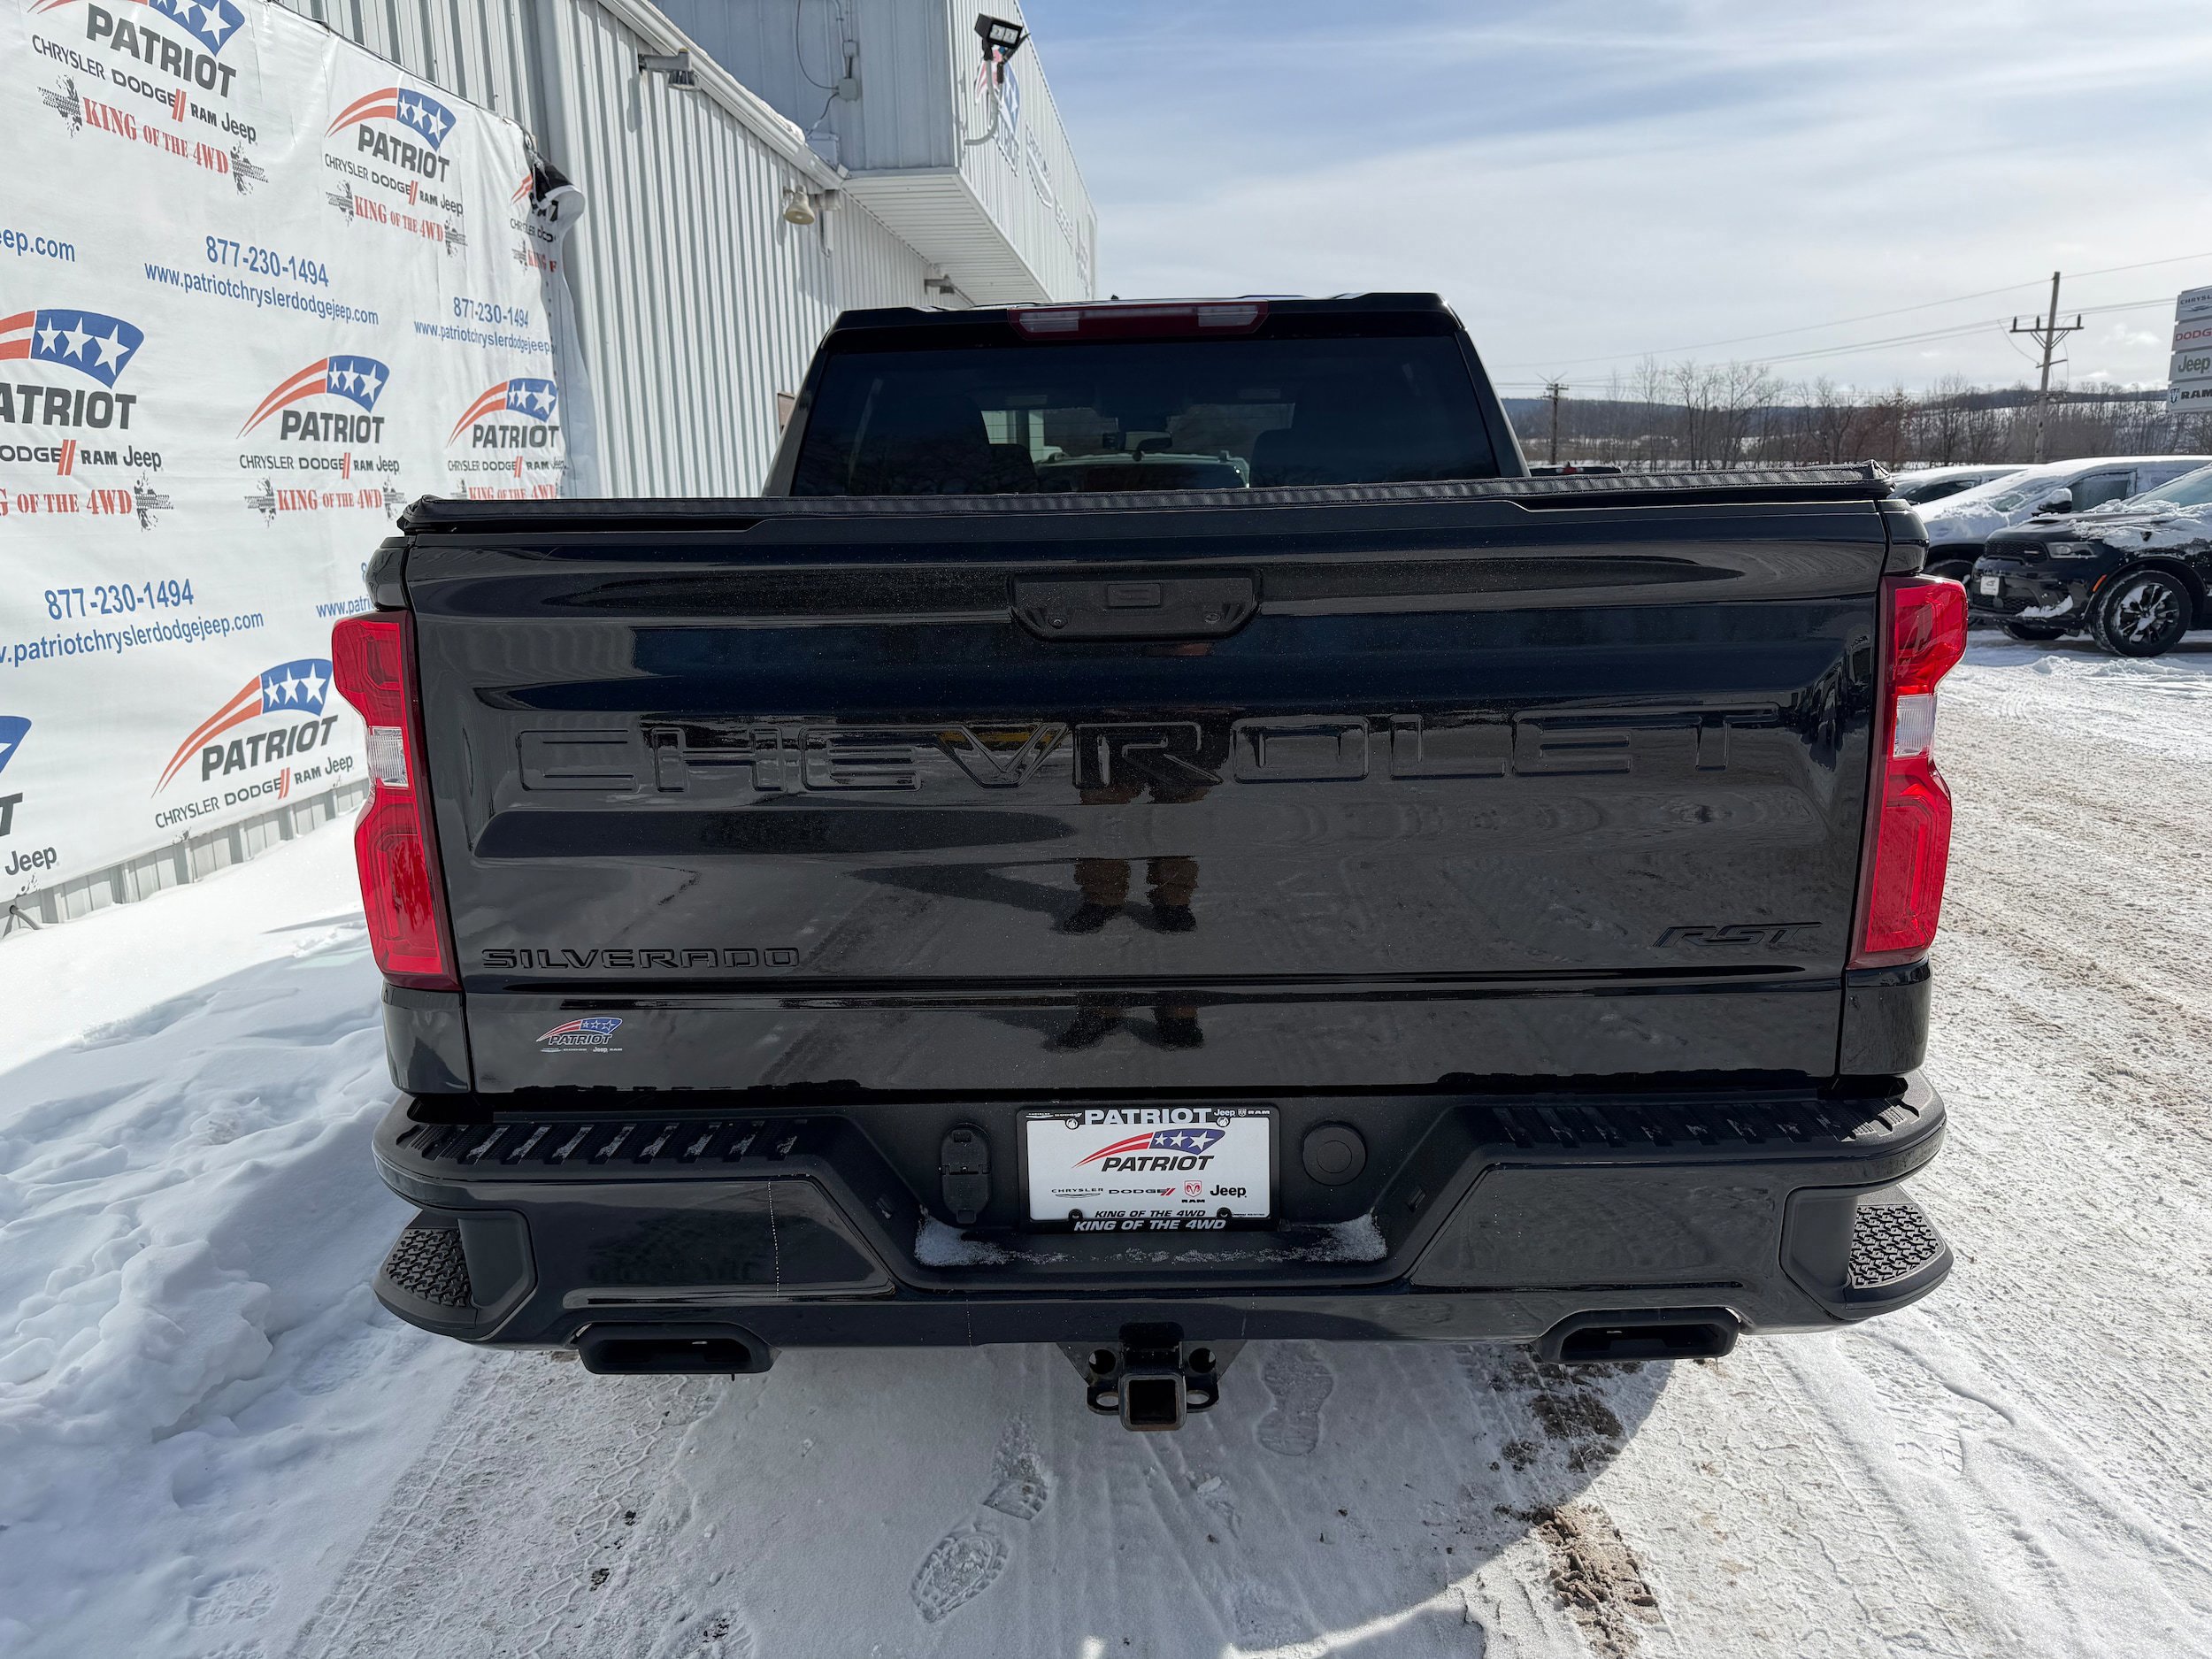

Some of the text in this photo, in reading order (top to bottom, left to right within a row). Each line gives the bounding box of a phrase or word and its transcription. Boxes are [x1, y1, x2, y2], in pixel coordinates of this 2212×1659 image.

[86, 3, 237, 98] PATRIOT
[32, 34, 257, 146] CHRYSLER DODGE RAM Jeep
[82, 96, 229, 174] KING OF THE 4WD
[357, 123, 449, 183] PATRIOT
[325, 153, 463, 218] CHRYSLER DODGE RAM Jeep
[354, 195, 443, 242] KING OF THE 4WD
[0, 228, 75, 263] ep.com
[206, 236, 328, 287] 877-230-1494
[144, 262, 379, 326] www.patriotchryslerdodgejeep.com
[454, 296, 529, 328] 877-230-1494
[2177, 356, 2210, 373] Jeep
[2181, 389, 2212, 399] RAM
[280, 410, 385, 443] PATRIOT
[472, 424, 560, 448] PATRIOT
[81, 449, 118, 465] RAM
[123, 445, 162, 472] Jeep
[240, 454, 399, 474] CHRYSLER DODGE RAM Jeep
[448, 460, 480, 472] CHRYSLER
[482, 461, 516, 471] DODGE
[526, 461, 549, 470] RAM
[17, 493, 39, 513] OF
[44, 494, 80, 513] THE
[87, 489, 132, 515] 4WD
[276, 488, 382, 511] KING OF THE 4WD
[468, 487, 494, 500] KING
[44, 579, 194, 620] 877-230-1494
[202, 715, 338, 782] PATRIOT
[516, 702, 1779, 793] CHEVROLET
[155, 755, 353, 829] CHRYSLER DODGE RAM Jeep
[5, 846, 57, 875] Jeep
[1652, 922, 1823, 948] RST
[482, 948, 800, 969] SILVERADO
[549, 1033, 613, 1045] PATRIOT
[1085, 1108, 1212, 1125] PATRIOT
[1102, 1155, 1214, 1171] PATRIOT
[1210, 1185, 1246, 1198] Jeep
[1074, 1218, 1226, 1231] KING OF THE 4WD
